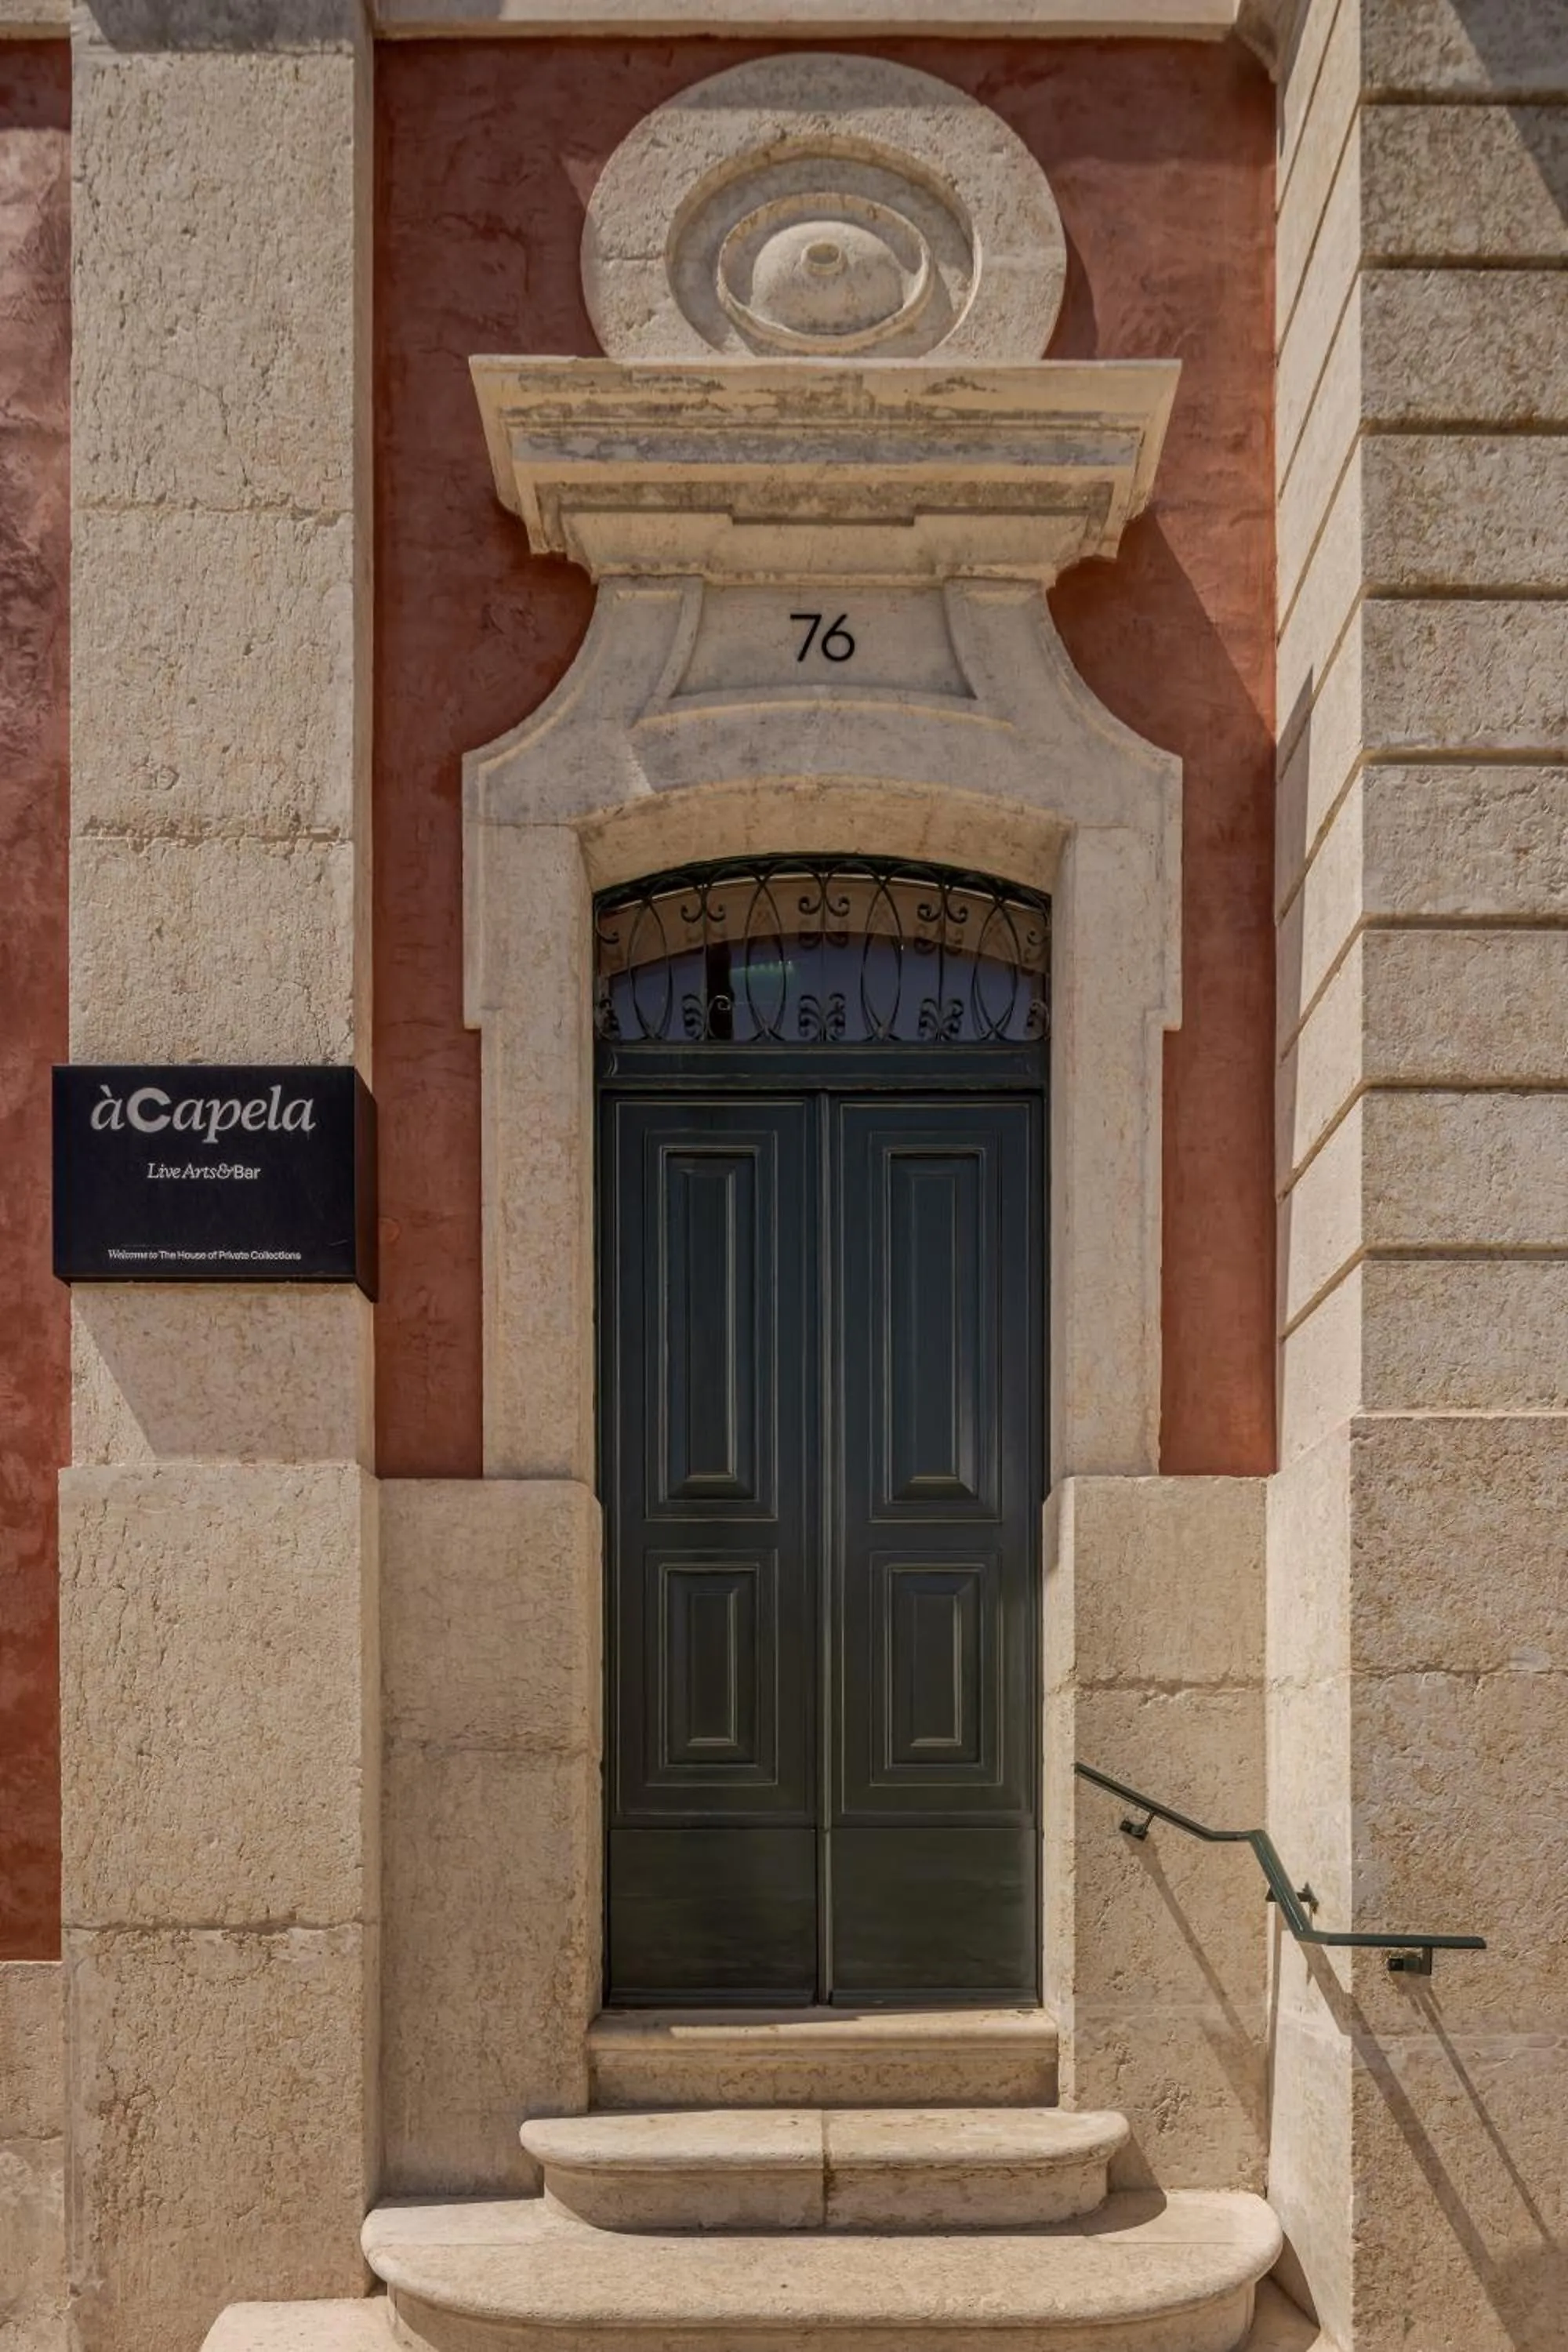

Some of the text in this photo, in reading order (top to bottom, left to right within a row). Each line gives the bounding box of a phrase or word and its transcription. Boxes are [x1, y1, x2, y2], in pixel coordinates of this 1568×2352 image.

[789, 613, 855, 662] 76
[147, 1162, 181, 1179] Live
[108, 1249, 302, 1260] Welcome to The House of Private Collections
